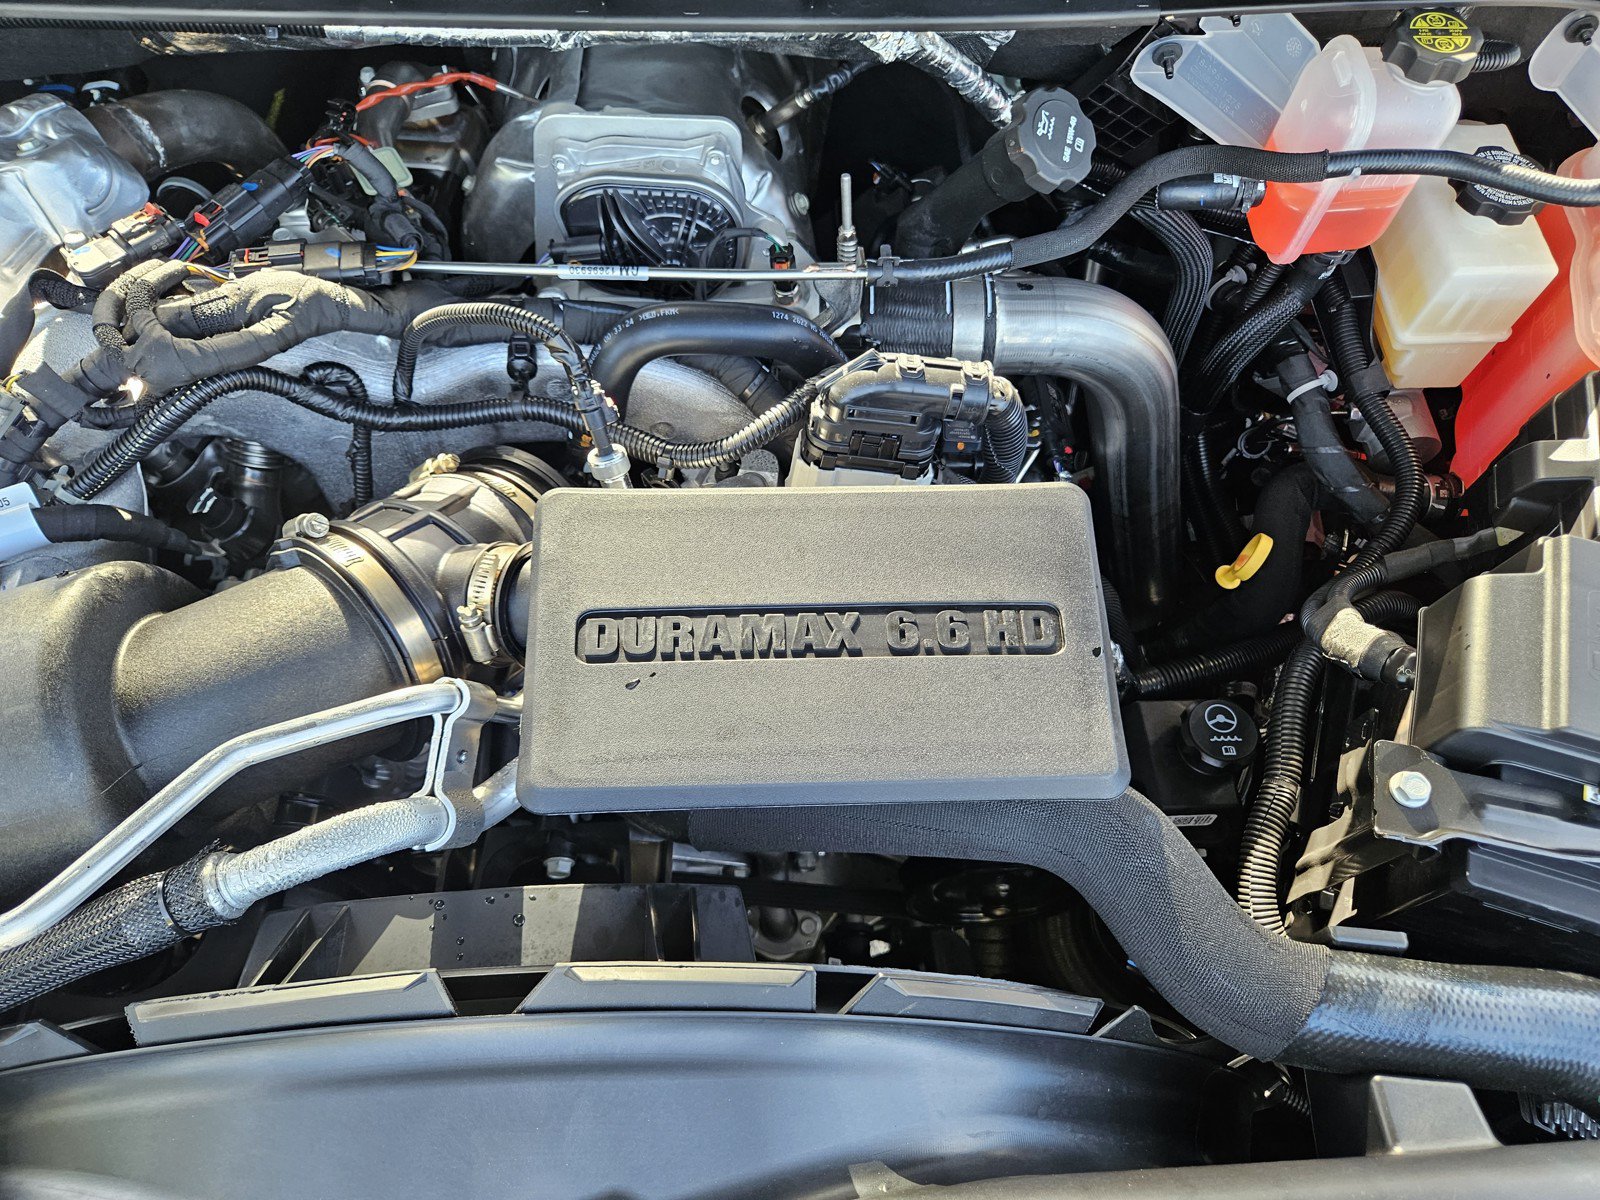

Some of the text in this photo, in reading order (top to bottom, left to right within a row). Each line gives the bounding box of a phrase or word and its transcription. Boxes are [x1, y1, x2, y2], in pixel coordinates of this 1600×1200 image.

[1063, 115, 1078, 163] SAE 15W-40
[620, 265, 639, 277] GM
[771, 311, 789, 321] 1274
[585, 609, 1058, 661] DURAMAX 6.6 HD
